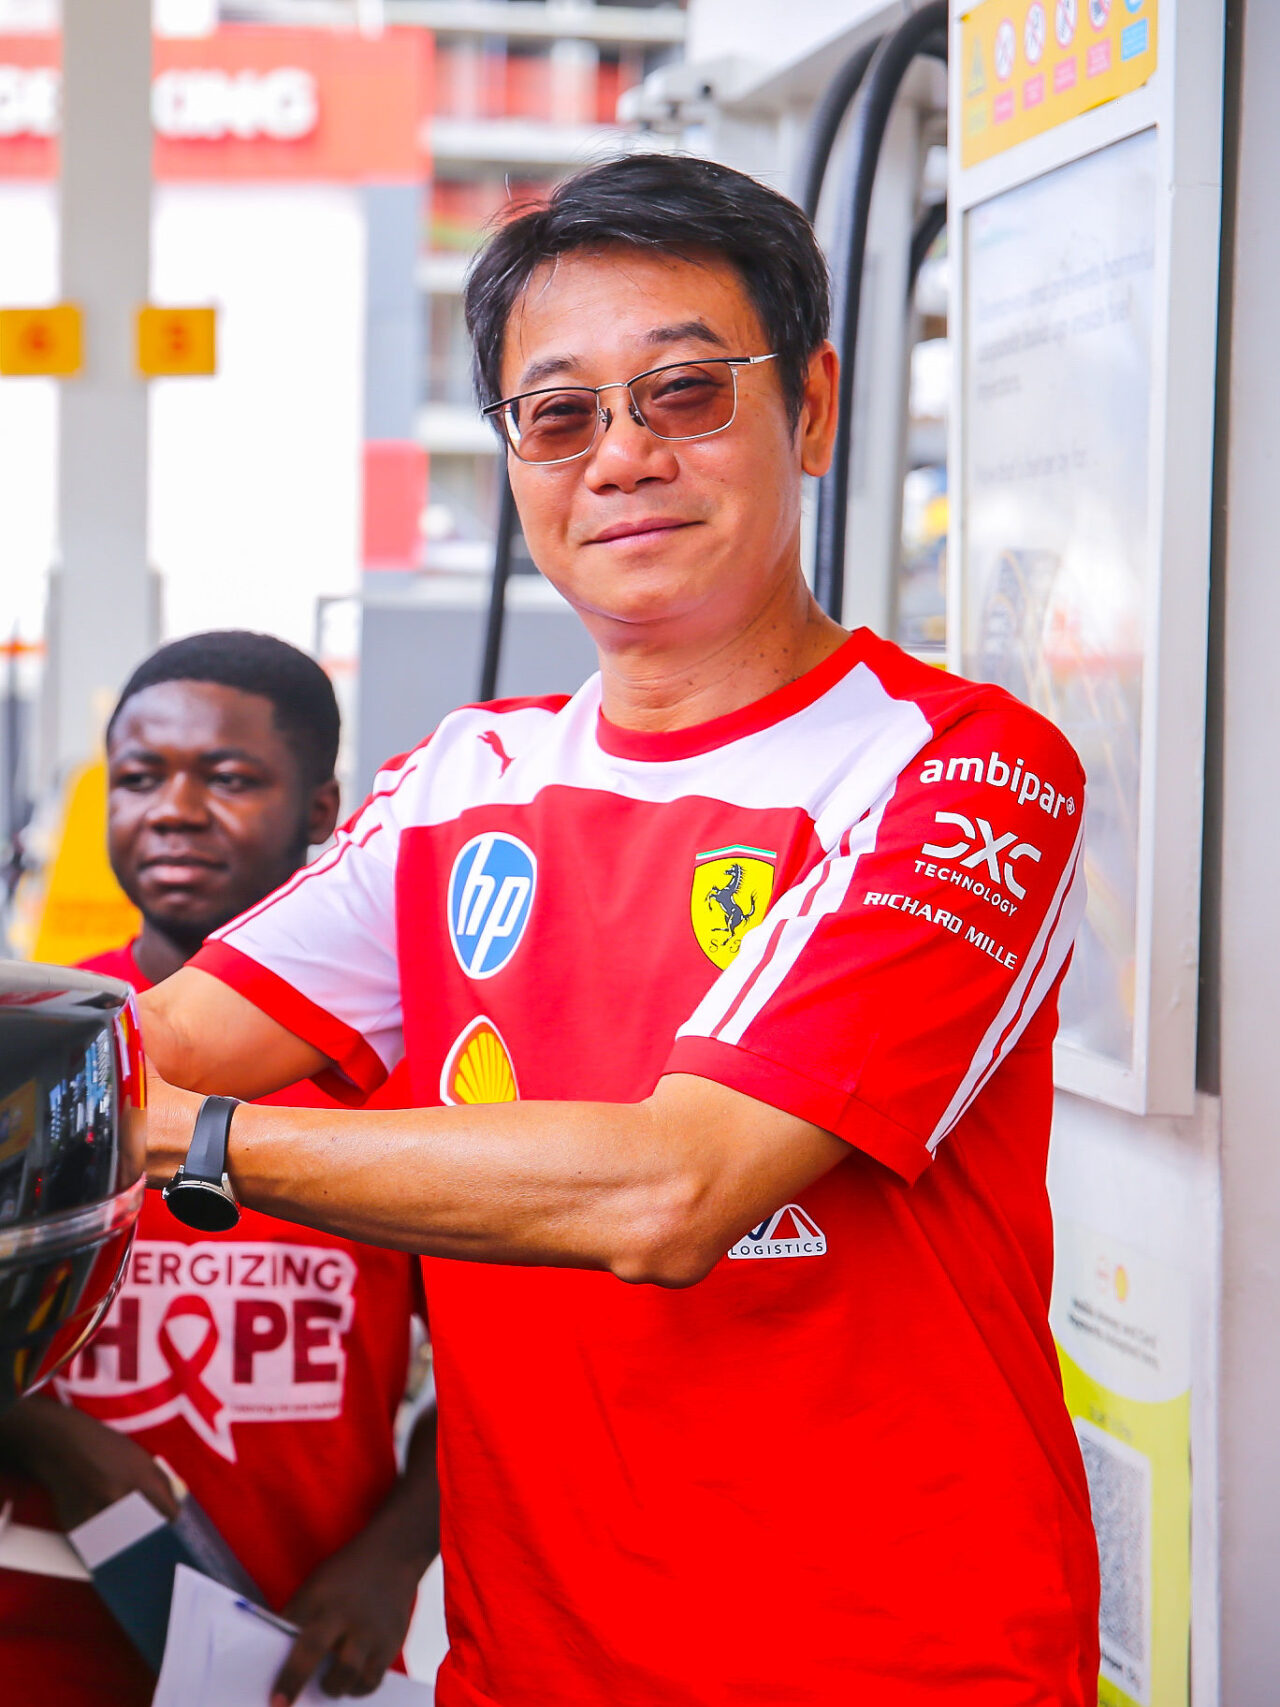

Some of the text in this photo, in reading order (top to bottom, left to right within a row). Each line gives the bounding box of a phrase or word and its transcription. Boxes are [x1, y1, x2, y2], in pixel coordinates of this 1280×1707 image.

[915, 860, 1018, 917] TECHNOLOGY
[921, 811, 1042, 900] DXC
[456, 836, 531, 974] hp
[863, 892, 1018, 970] RICHARD MILLE
[123, 1251, 342, 1292] ERGIZING
[730, 1242, 823, 1256] LOGISTICS
